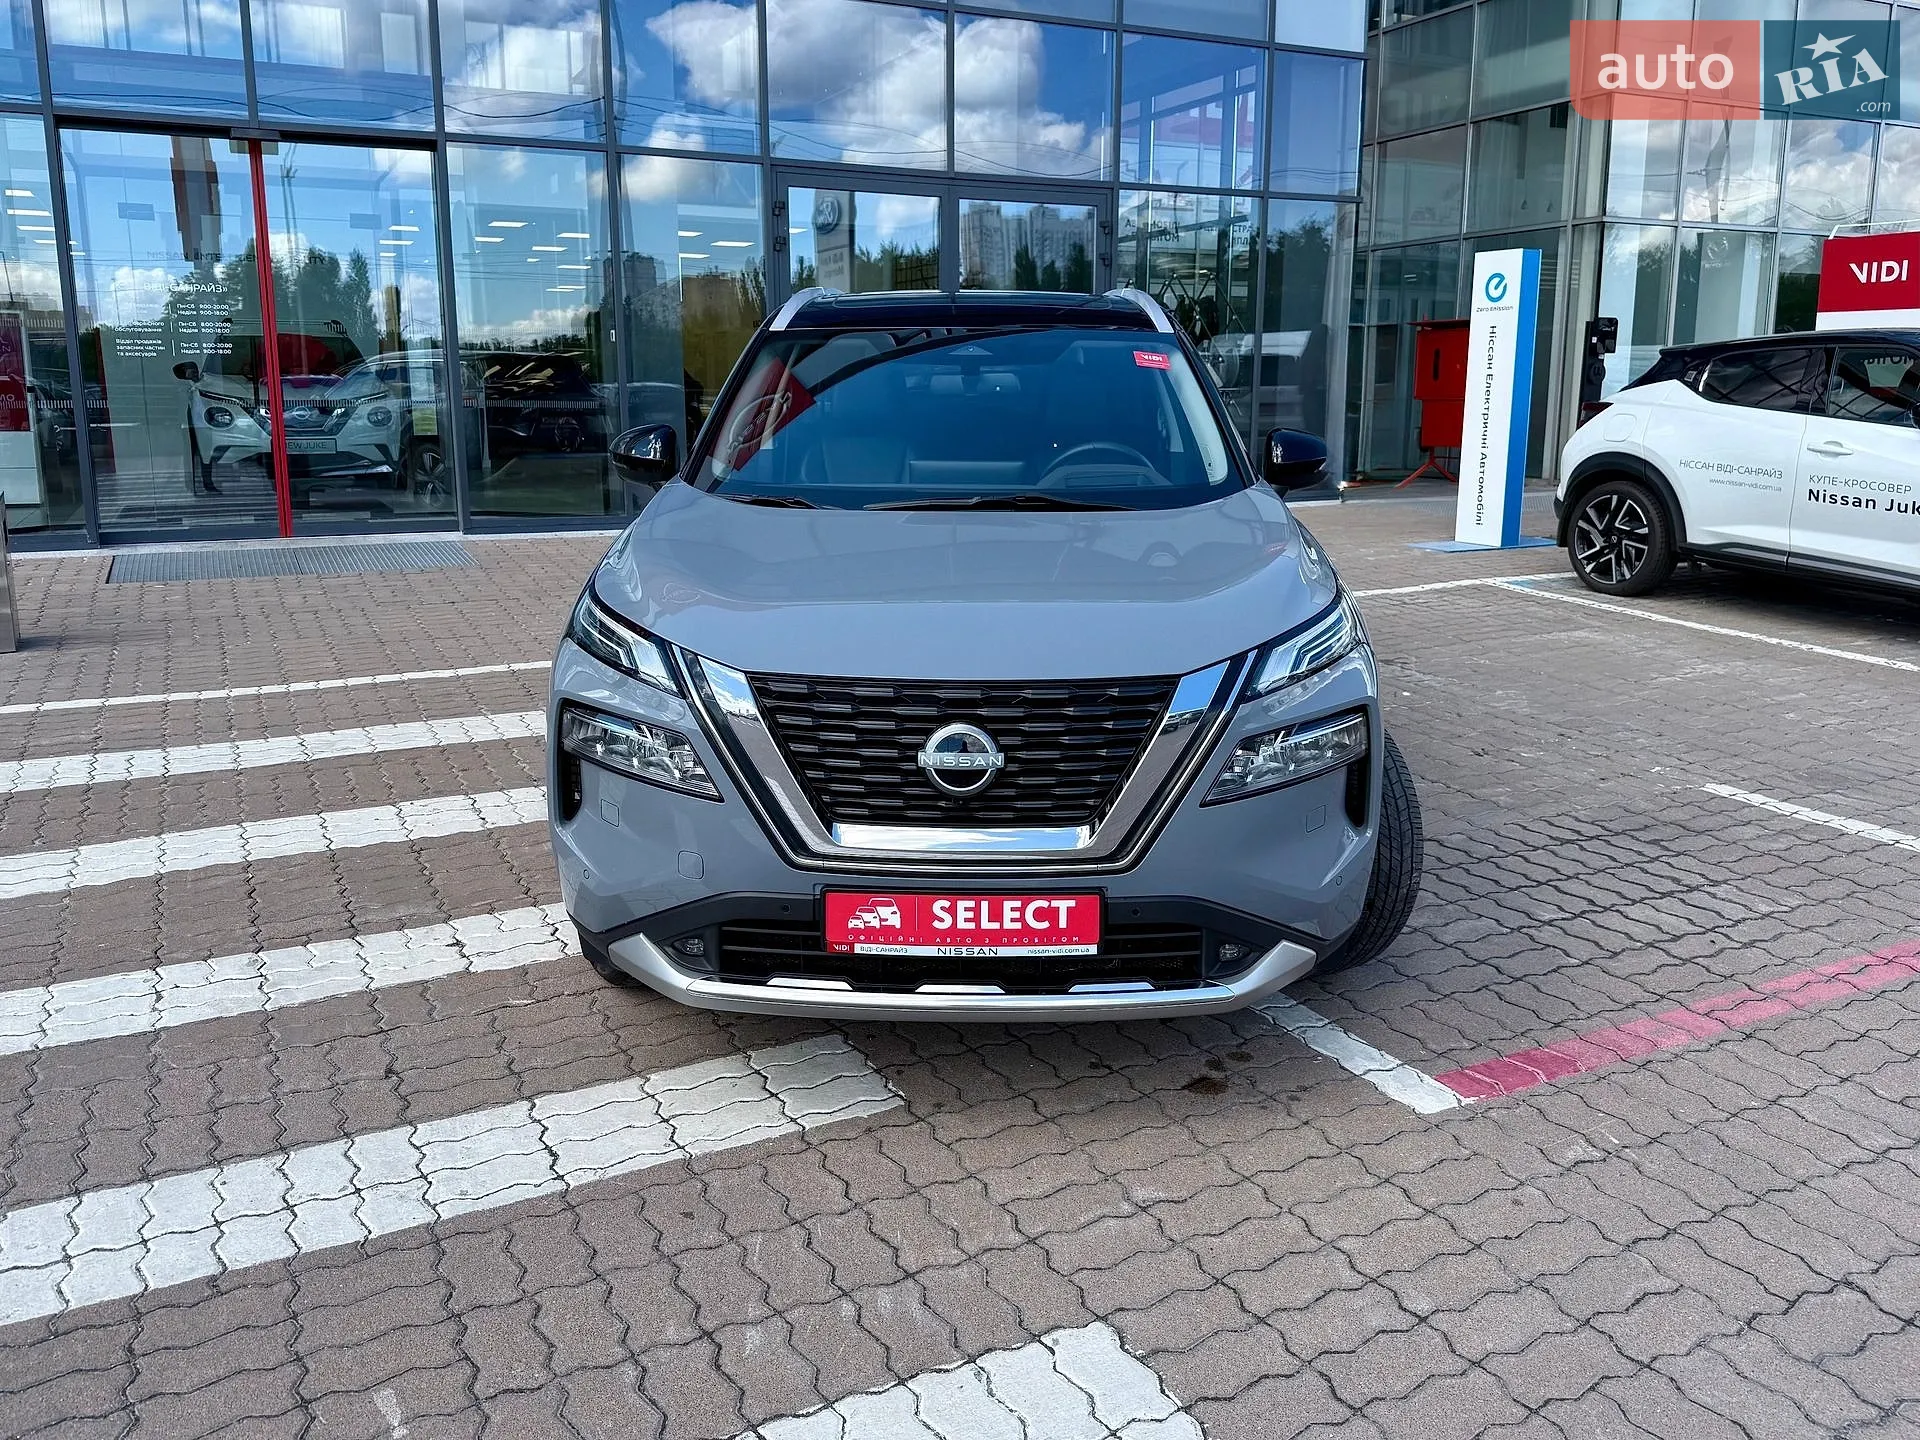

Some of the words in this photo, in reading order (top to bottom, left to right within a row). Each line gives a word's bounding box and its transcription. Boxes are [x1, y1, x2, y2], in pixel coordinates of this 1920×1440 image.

[1848, 260, 1909, 284] VIDI
[1486, 324, 1498, 371] Ніссан
[1140, 353, 1163, 362] VIDI
[1480, 373, 1494, 449] Електричні
[303, 441, 327, 449] JUKE
[1679, 458, 1715, 472] НІССАН
[1716, 462, 1783, 480] ВІДІ-САНРАЙЗ
[1475, 452, 1488, 526] Автомобілі
[1709, 478, 1782, 493] www.nissan-vidi.com.ua
[1808, 474, 1912, 494] КУПЕ-КРОСОВЕР
[1807, 488, 1877, 510] Nissan
[920, 754, 1002, 767] NISSAN
[931, 898, 1076, 930] SELECT
[848, 934, 923, 943] ОФІЦІЙНІ
[935, 936, 972, 944] АВТО
[1002, 936, 1080, 944] ПРОБІГОМ
[833, 943, 850, 952] VIDI
[859, 945, 908, 954] ВІДІ-САНРАЙЗ
[937, 947, 998, 956] NISSAN
[1027, 947, 1090, 955] nissan-vidi.com.ua
